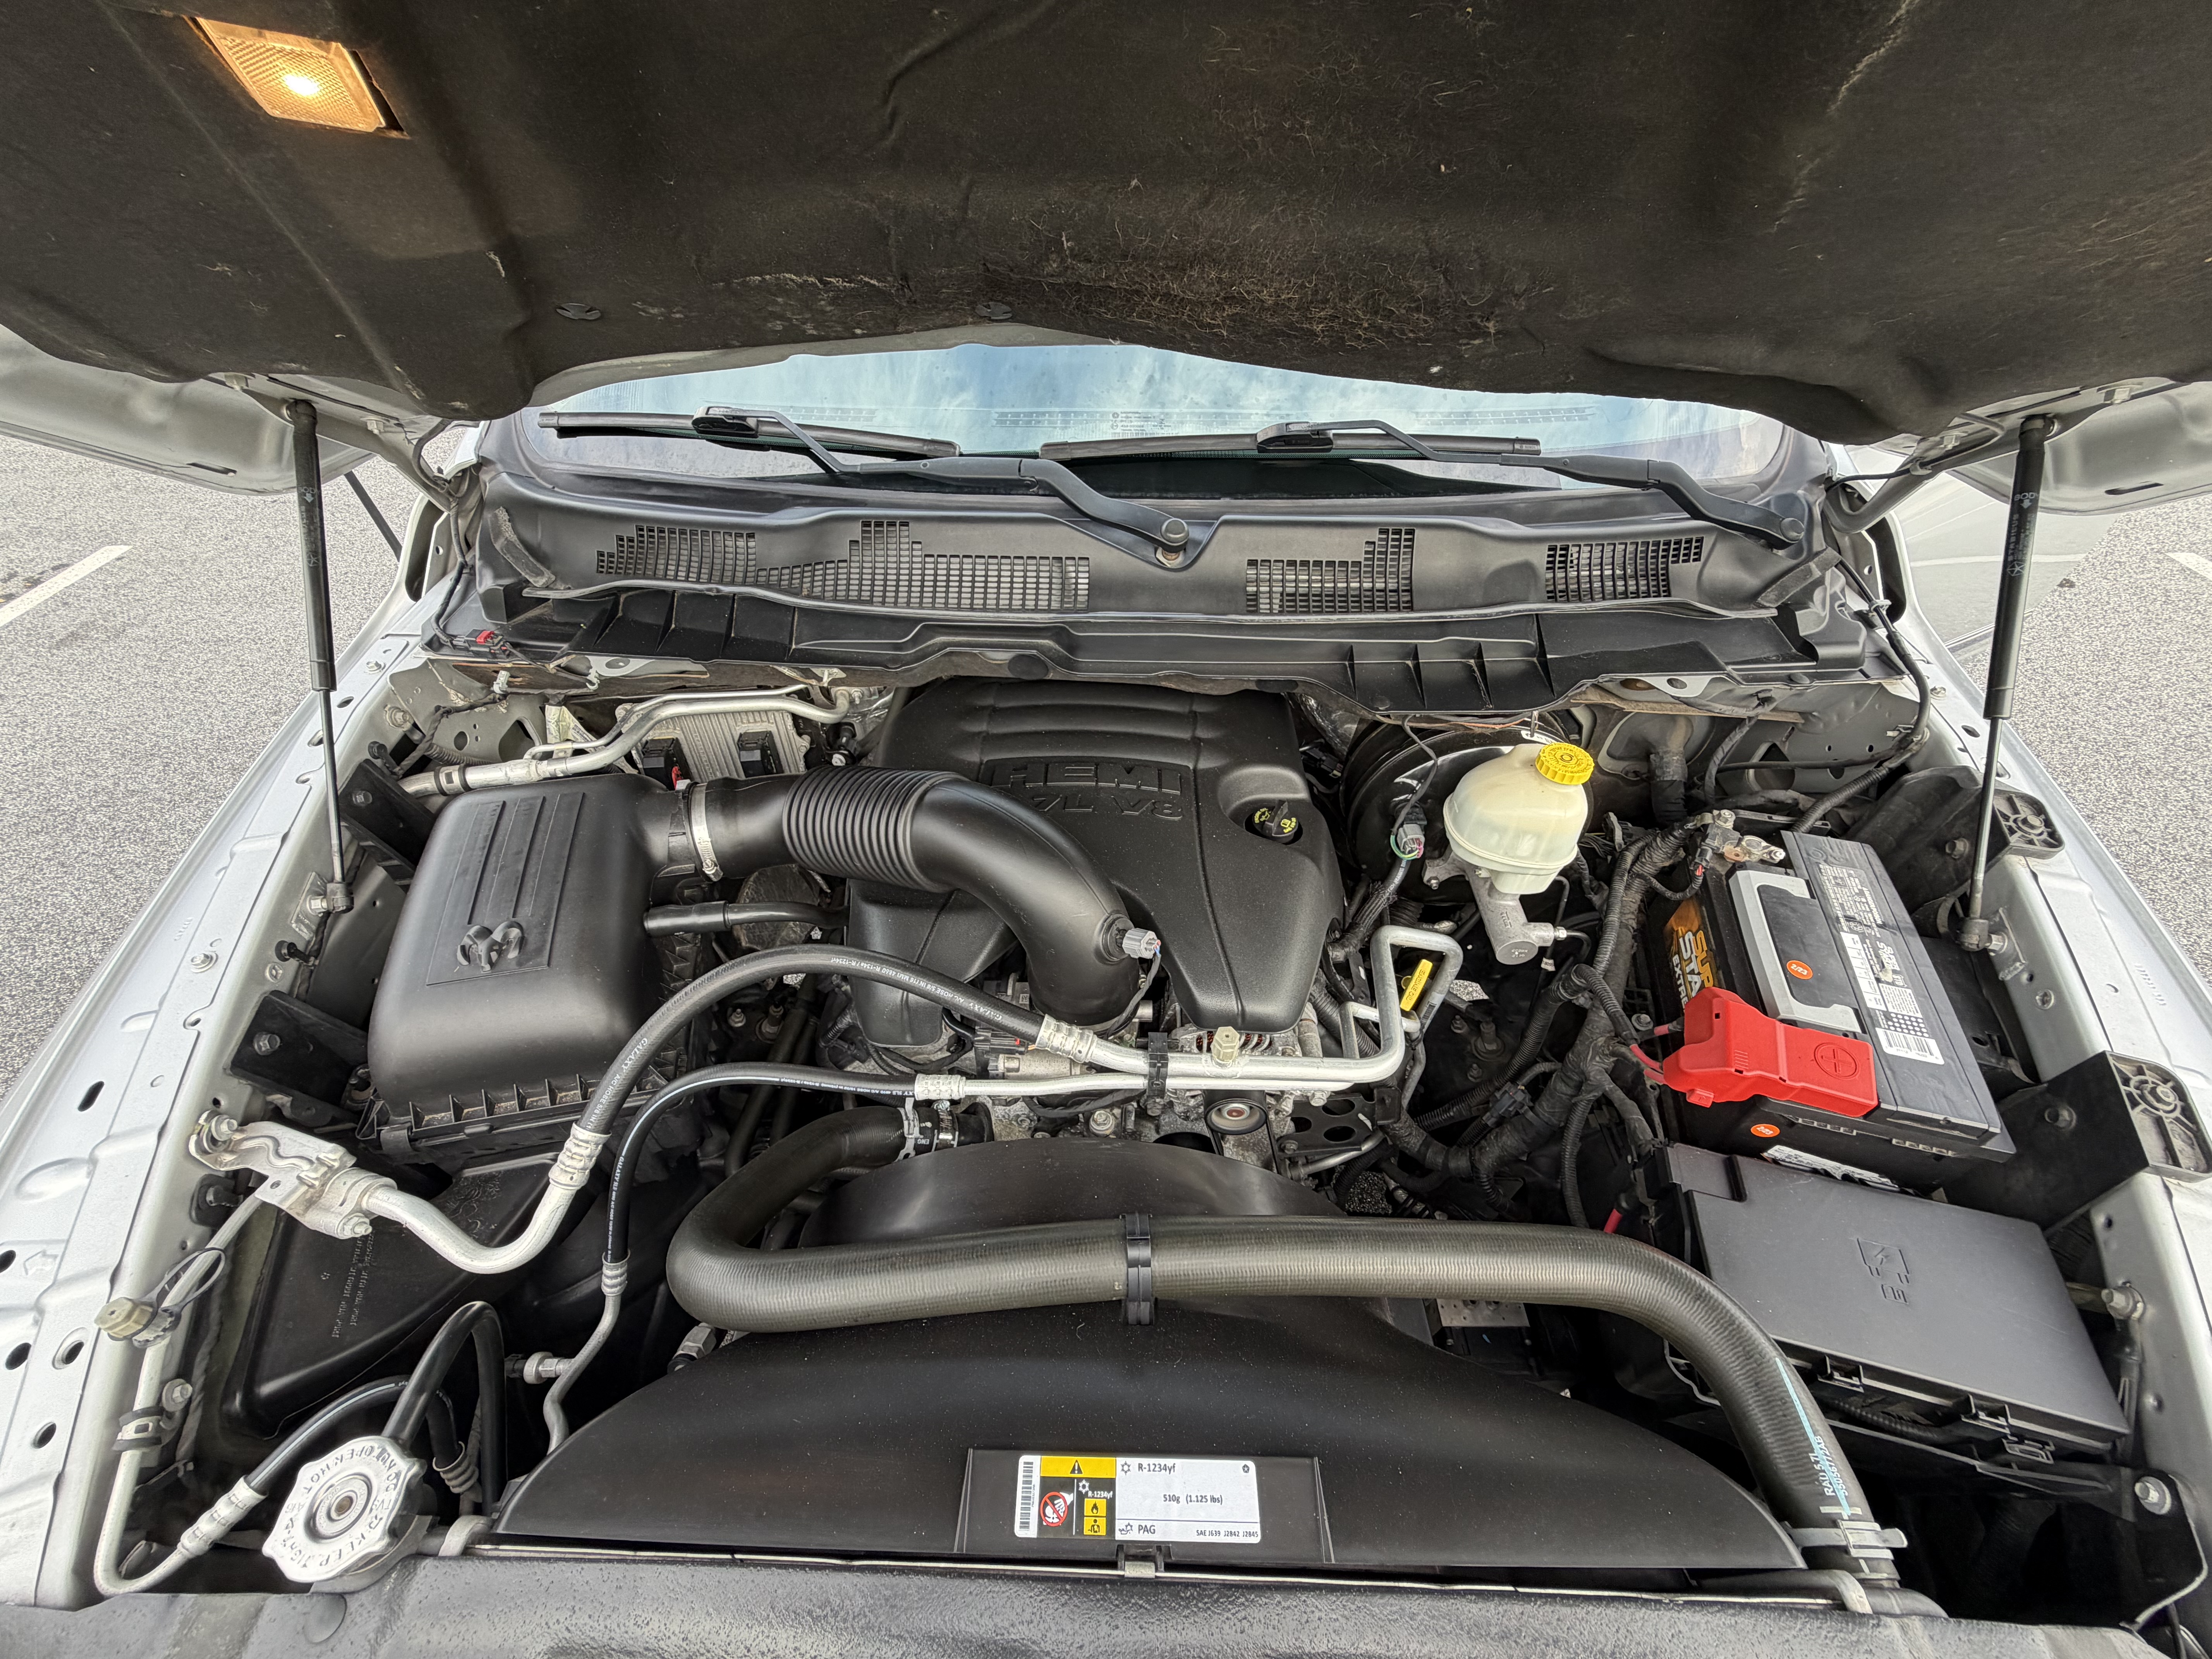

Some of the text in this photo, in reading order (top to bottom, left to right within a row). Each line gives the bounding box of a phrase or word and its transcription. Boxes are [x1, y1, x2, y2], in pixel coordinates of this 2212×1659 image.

[991, 762, 1181, 796] HEMI
[1032, 794, 1183, 821] 7L V8
[1679, 931, 1700, 997] STA
[1692, 930, 1714, 988] SUP
[1886, 947, 1900, 970] SUPER
[926, 983, 936, 992] 5/8
[1412, 969, 1426, 992] ENGINE
[1673, 954, 1688, 1013] EXTRE
[936, 988, 953, 998] HOSE
[953, 995, 965, 1004] A/C
[1406, 991, 1415, 1001] OIL
[968, 1001, 1002, 1021] GALAXY
[620, 1037, 649, 1072] GALAXY
[611, 1074, 620, 1086] A/C
[599, 1086, 613, 1104] HOSE
[589, 1114, 598, 1123] IN
[594, 1104, 603, 1114] 5/8
[615, 1157, 624, 1182] GALAXY
[303, 1463, 330, 1494] HOT
[1138, 1463, 1176, 1475] R-1234yf
[1087, 1490, 1113, 1499] R-1234yf
[1163, 1494, 1223, 1505] 510g (1.125 lbs)
[1138, 1524, 1156, 1534] PAG
[319, 1533, 366, 1567] KEEP
